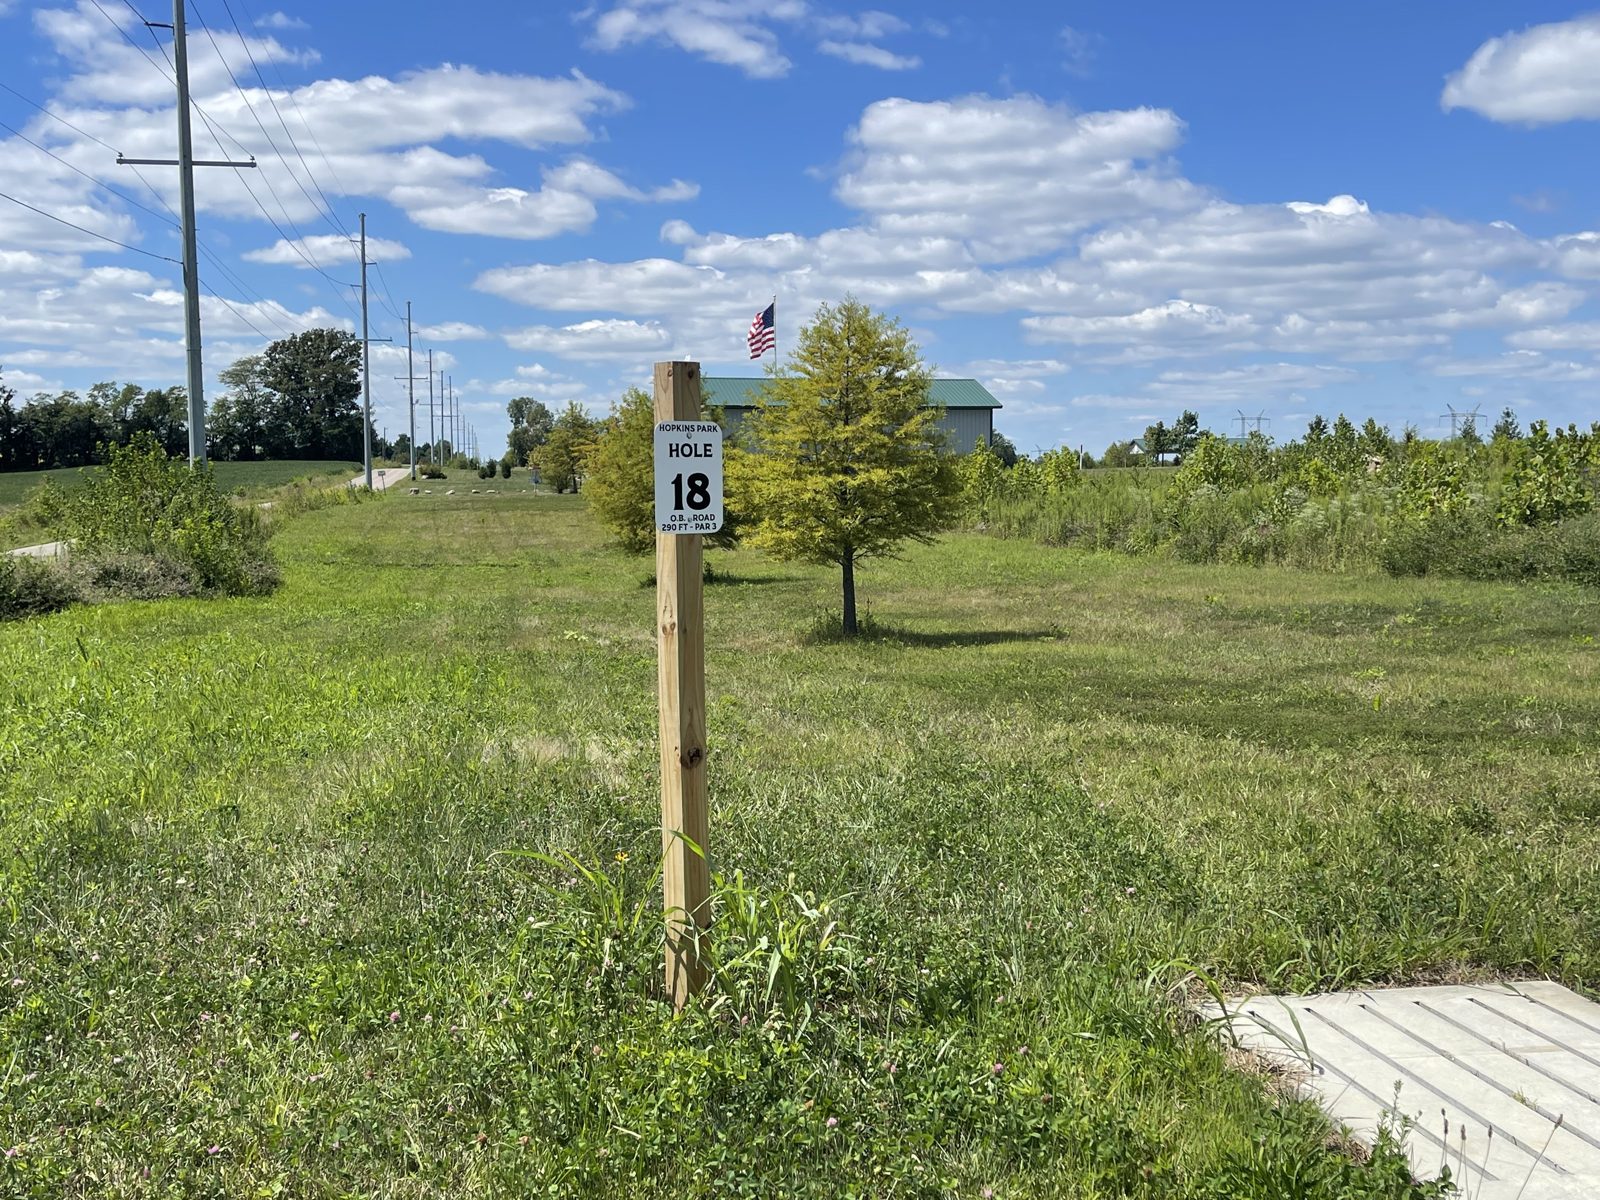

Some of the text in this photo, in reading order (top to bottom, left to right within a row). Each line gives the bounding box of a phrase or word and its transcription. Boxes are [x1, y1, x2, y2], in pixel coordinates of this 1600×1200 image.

[659, 424, 718, 433] HOPKINS PARK
[669, 443, 713, 458] HOLE
[671, 472, 711, 510] 18
[693, 514, 715, 522] ROAD
[712, 522, 717, 530] 3
